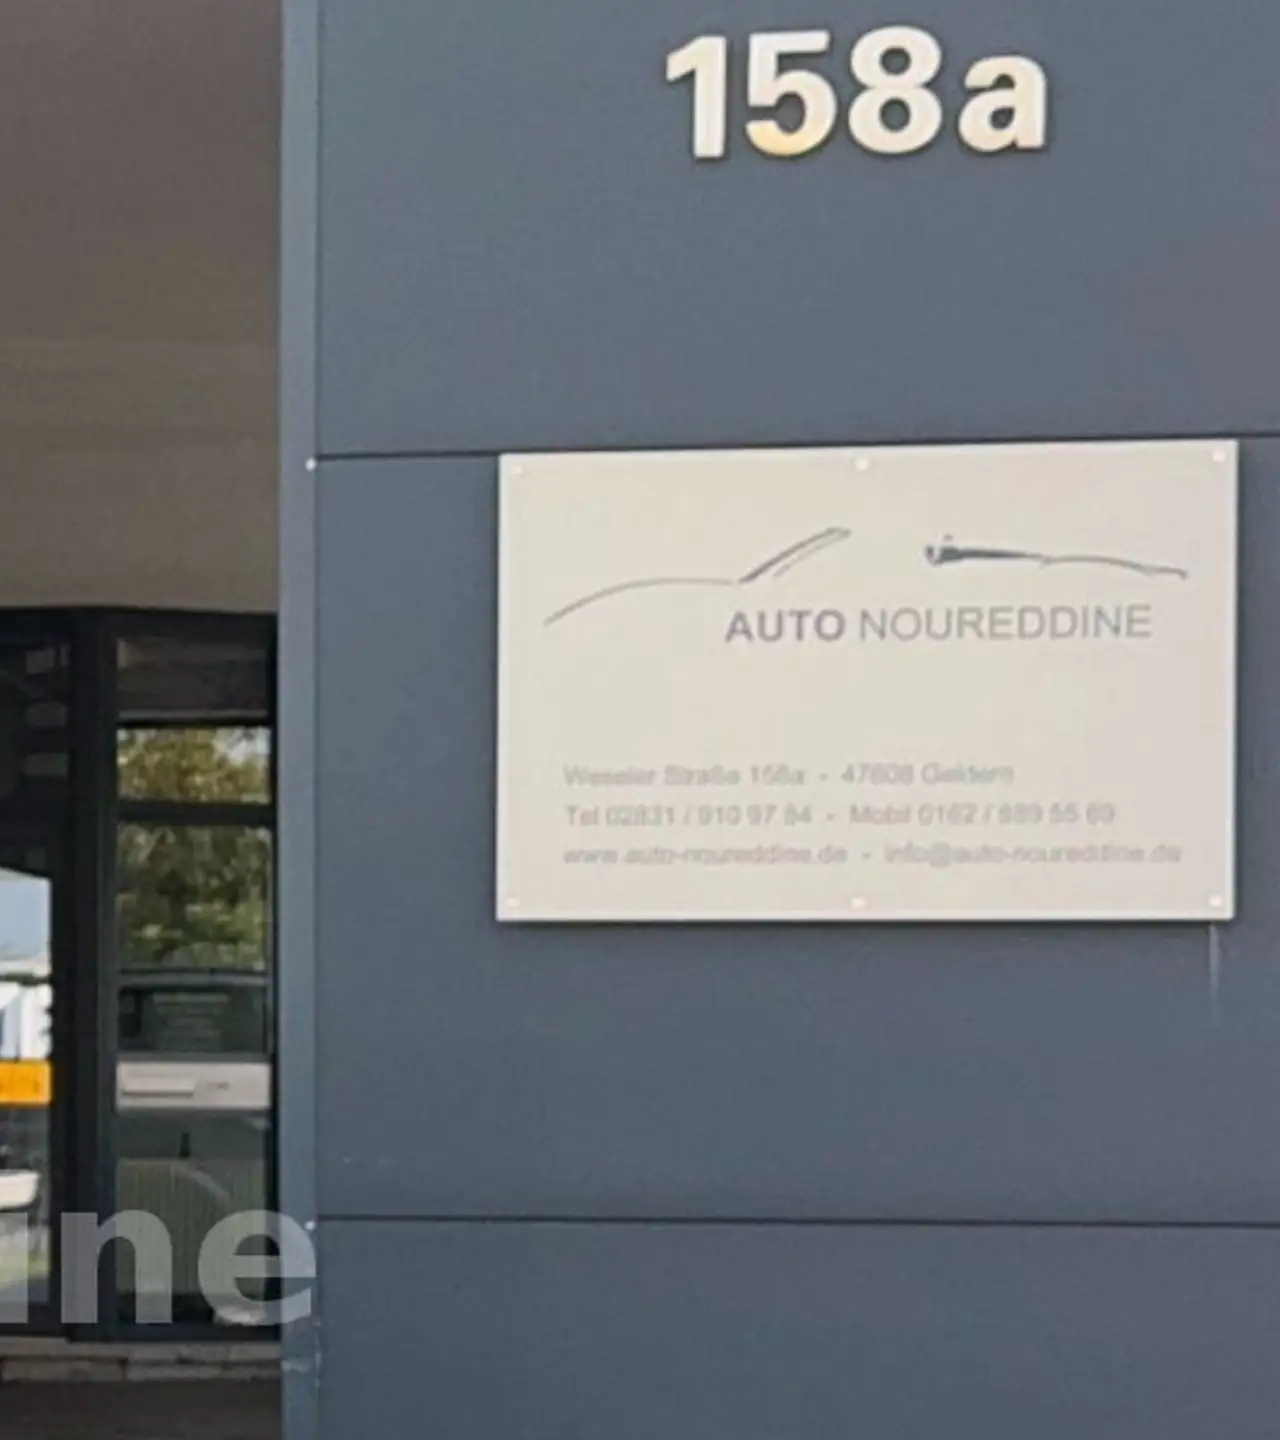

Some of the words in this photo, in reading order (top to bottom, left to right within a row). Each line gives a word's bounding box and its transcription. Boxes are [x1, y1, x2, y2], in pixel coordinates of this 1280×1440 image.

[665, 24, 1049, 160] 158a
[724, 610, 846, 643] AUTO
[859, 604, 1153, 641] NOUREDDINE
